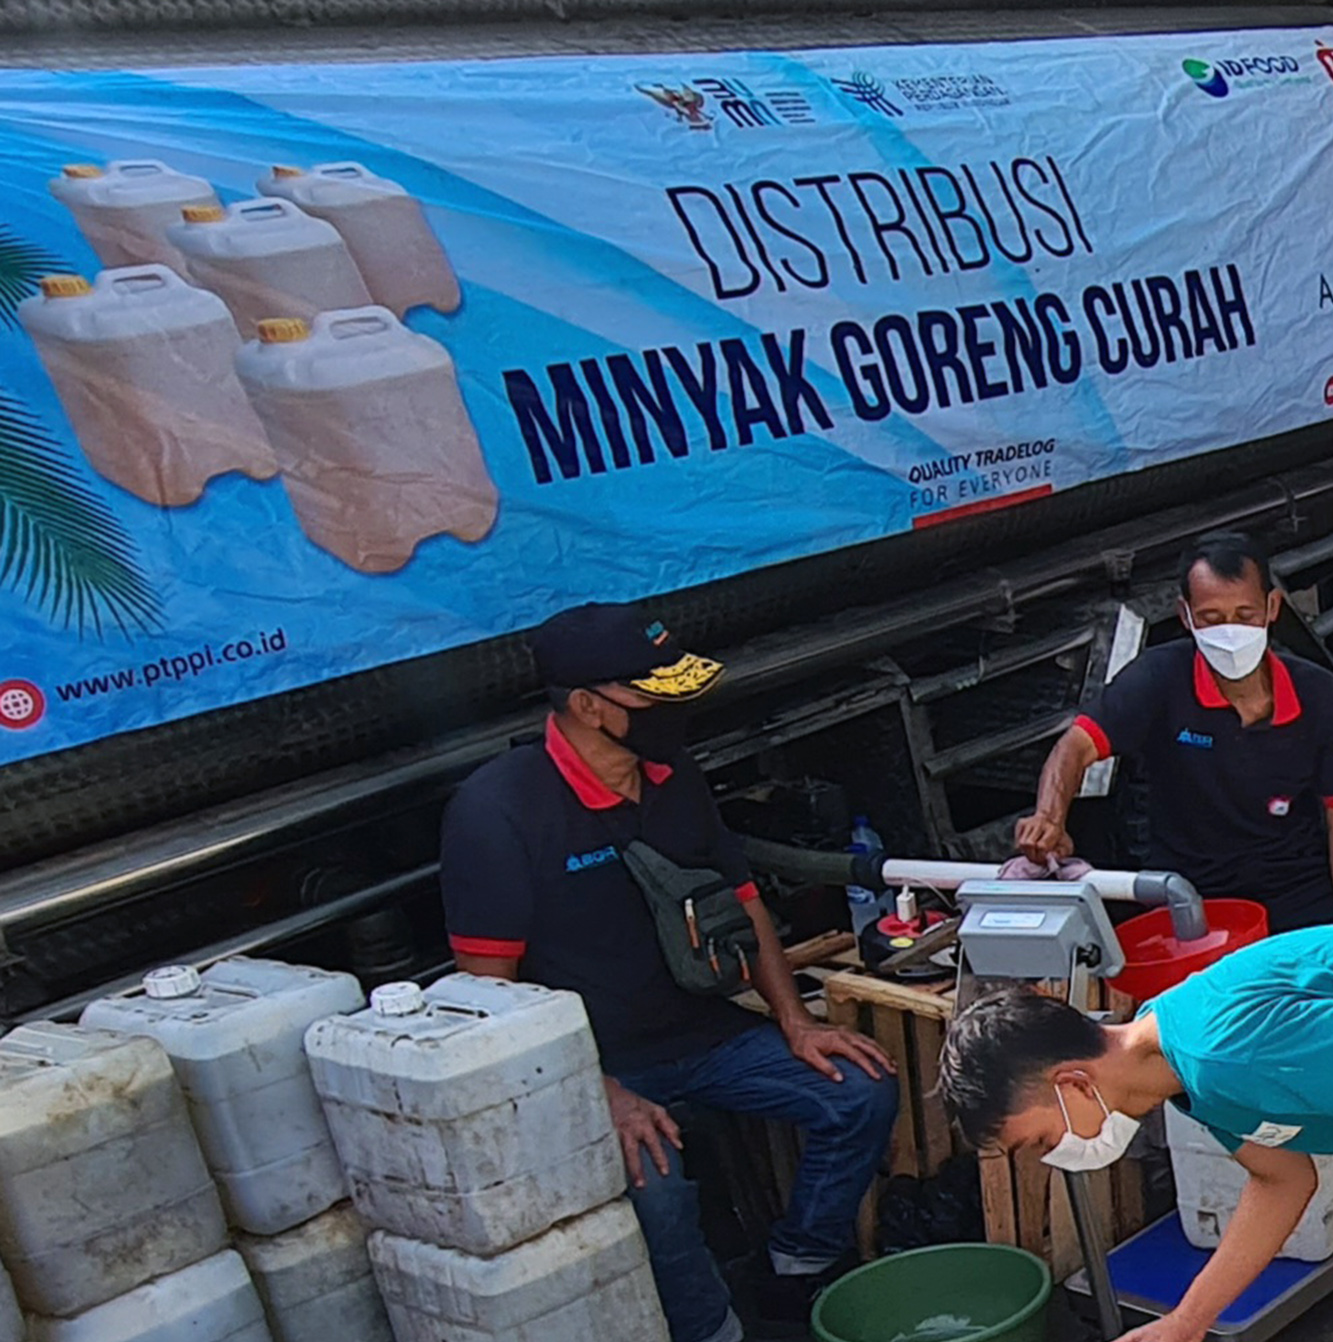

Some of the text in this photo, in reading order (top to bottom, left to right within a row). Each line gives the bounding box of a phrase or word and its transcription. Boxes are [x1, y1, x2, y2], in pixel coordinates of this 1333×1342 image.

[1245, 56, 1299, 75] FOOD
[665, 157, 1094, 300] DISTRIBUSI
[502, 328, 835, 486] MINYAK
[830, 292, 1082, 422] GORENG
[1081, 263, 1256, 375] CURAH
[908, 438, 1056, 484] QUALITY TRADELOG
[909, 460, 1052, 508] FOR EVERYONE
[56, 628, 287, 701] www.ptppi.co.id
